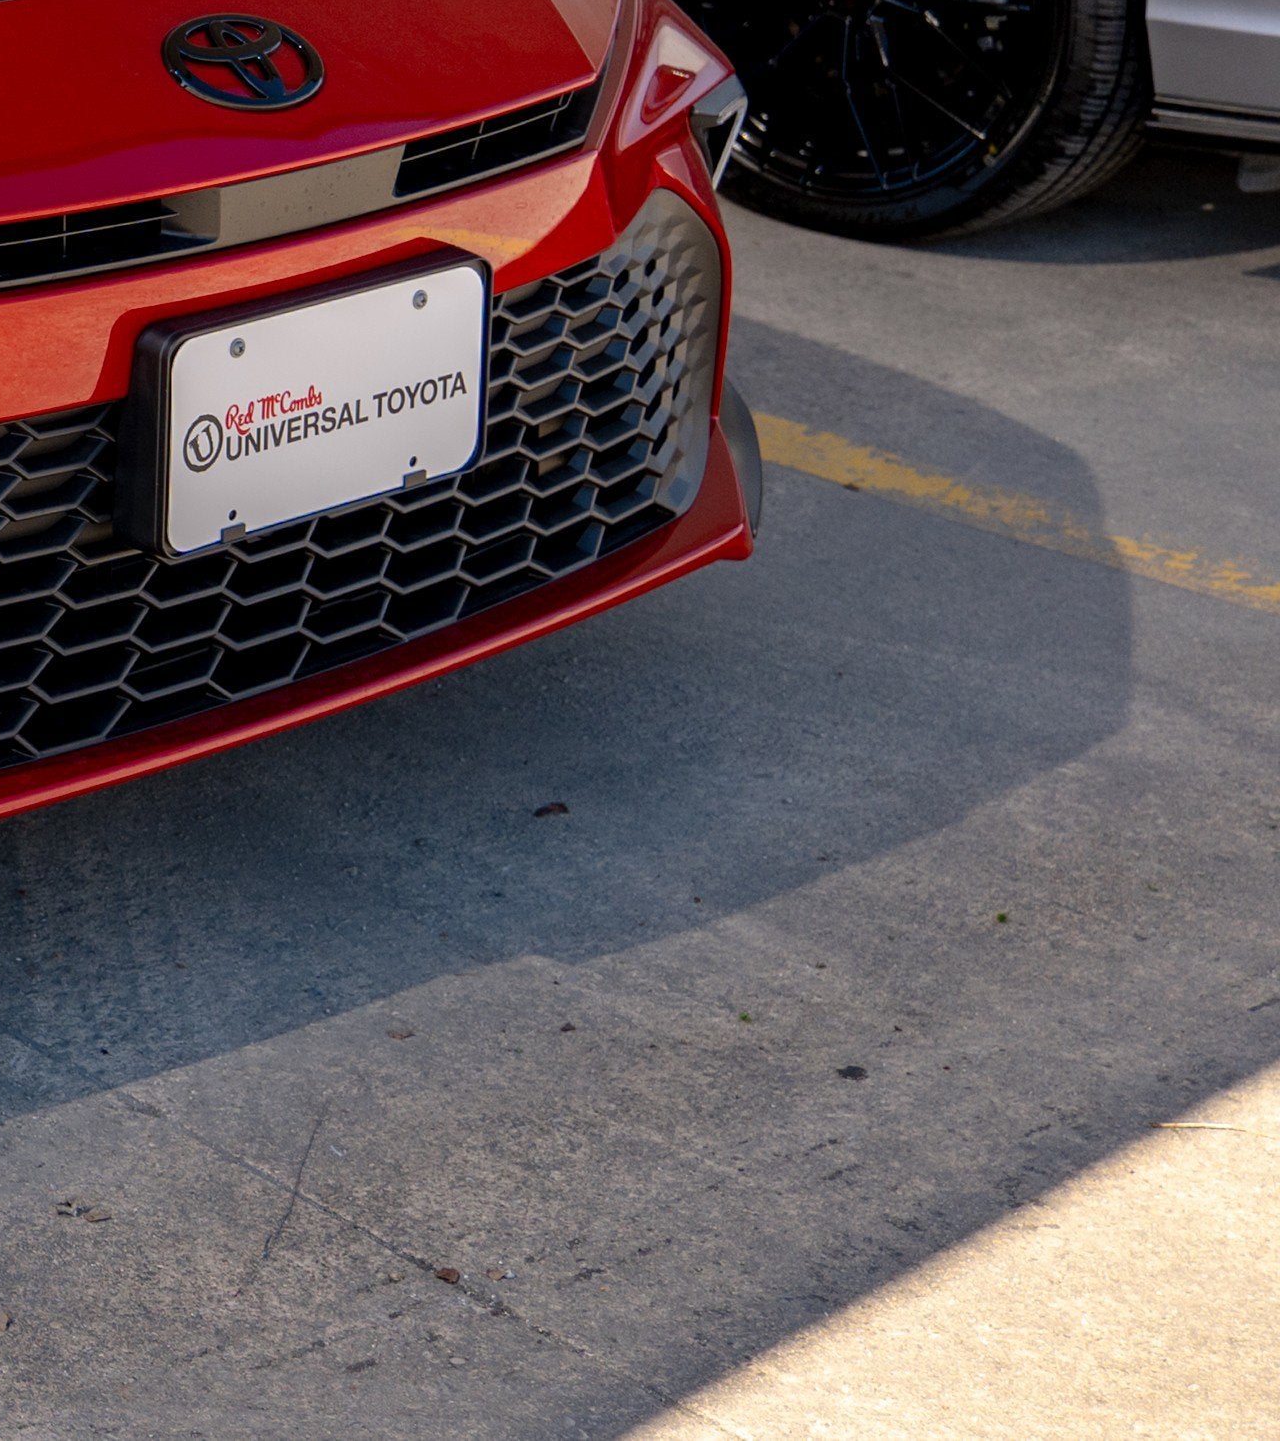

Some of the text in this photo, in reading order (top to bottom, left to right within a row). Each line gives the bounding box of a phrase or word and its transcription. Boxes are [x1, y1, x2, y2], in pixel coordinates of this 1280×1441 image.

[225, 385, 323, 436] Red McCombs
[226, 371, 468, 461] UNIVERSAL TOYOTA
